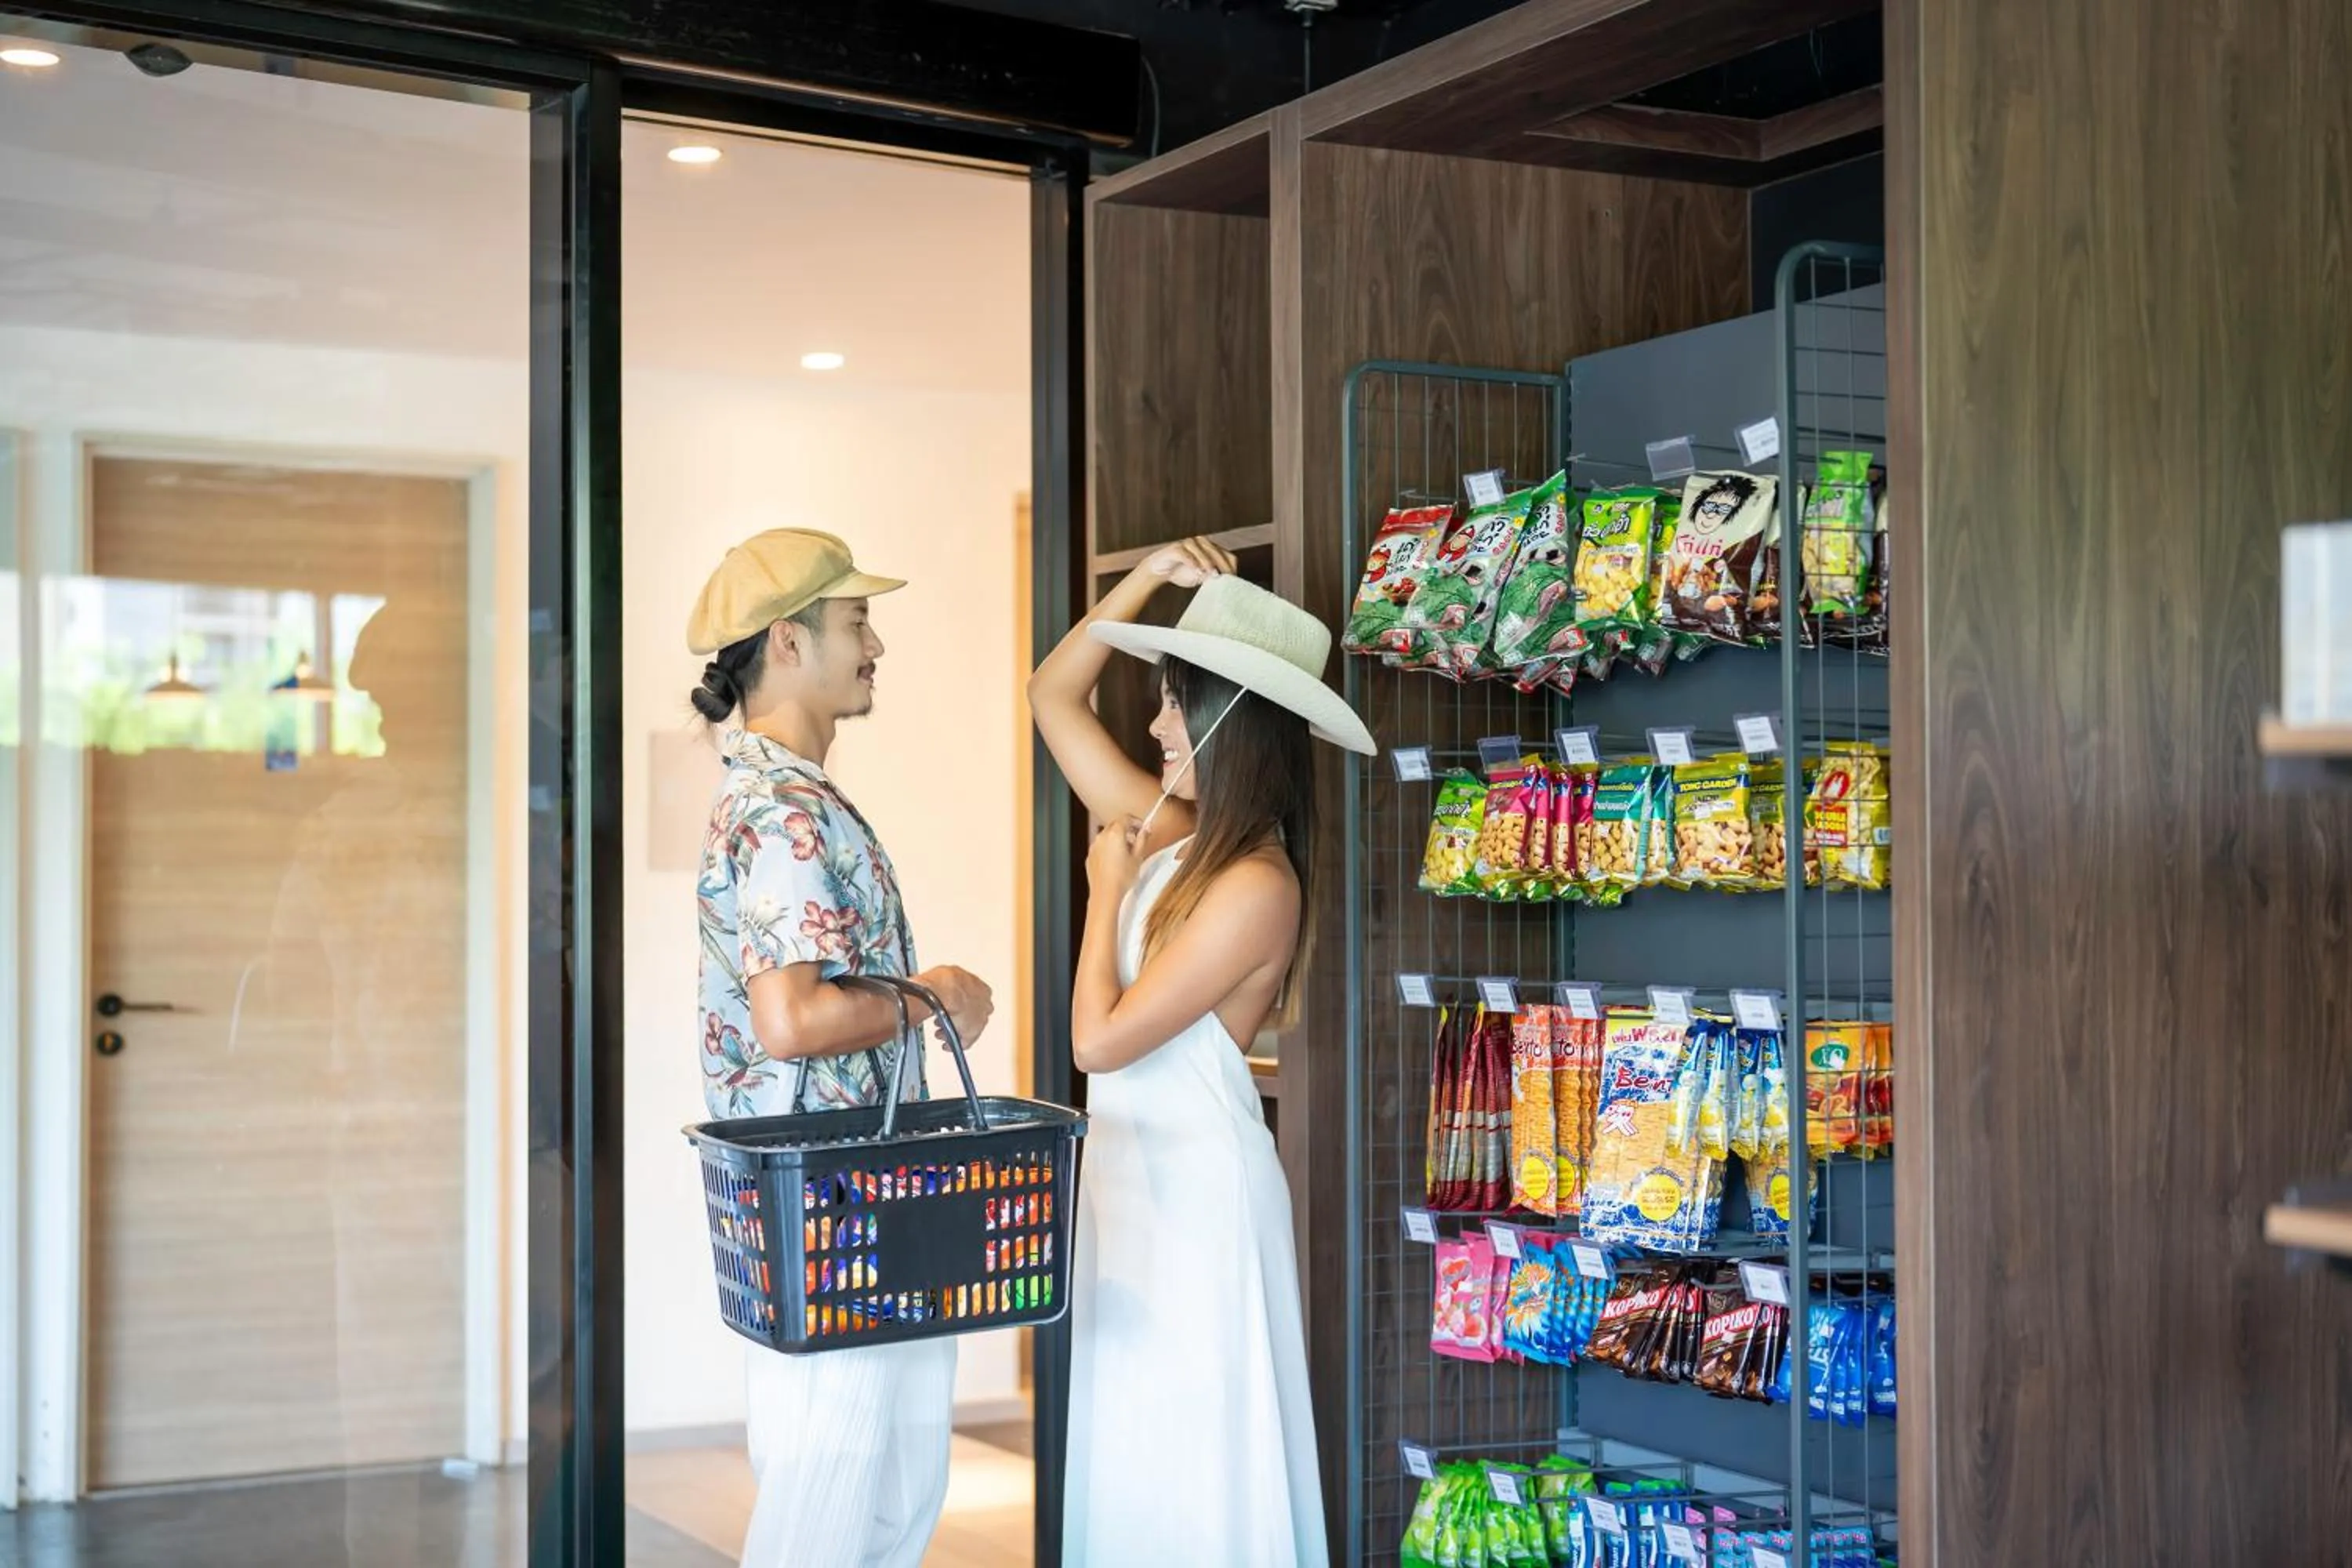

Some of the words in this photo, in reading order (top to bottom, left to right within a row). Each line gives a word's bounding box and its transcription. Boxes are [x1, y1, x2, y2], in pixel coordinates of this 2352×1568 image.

[1702, 778, 1737, 789] GARDEN
[1615, 1065, 1672, 1091] Bent
[1603, 1290, 1660, 1318] KOPKO
[1705, 1306, 1754, 1337] KOPIKO
